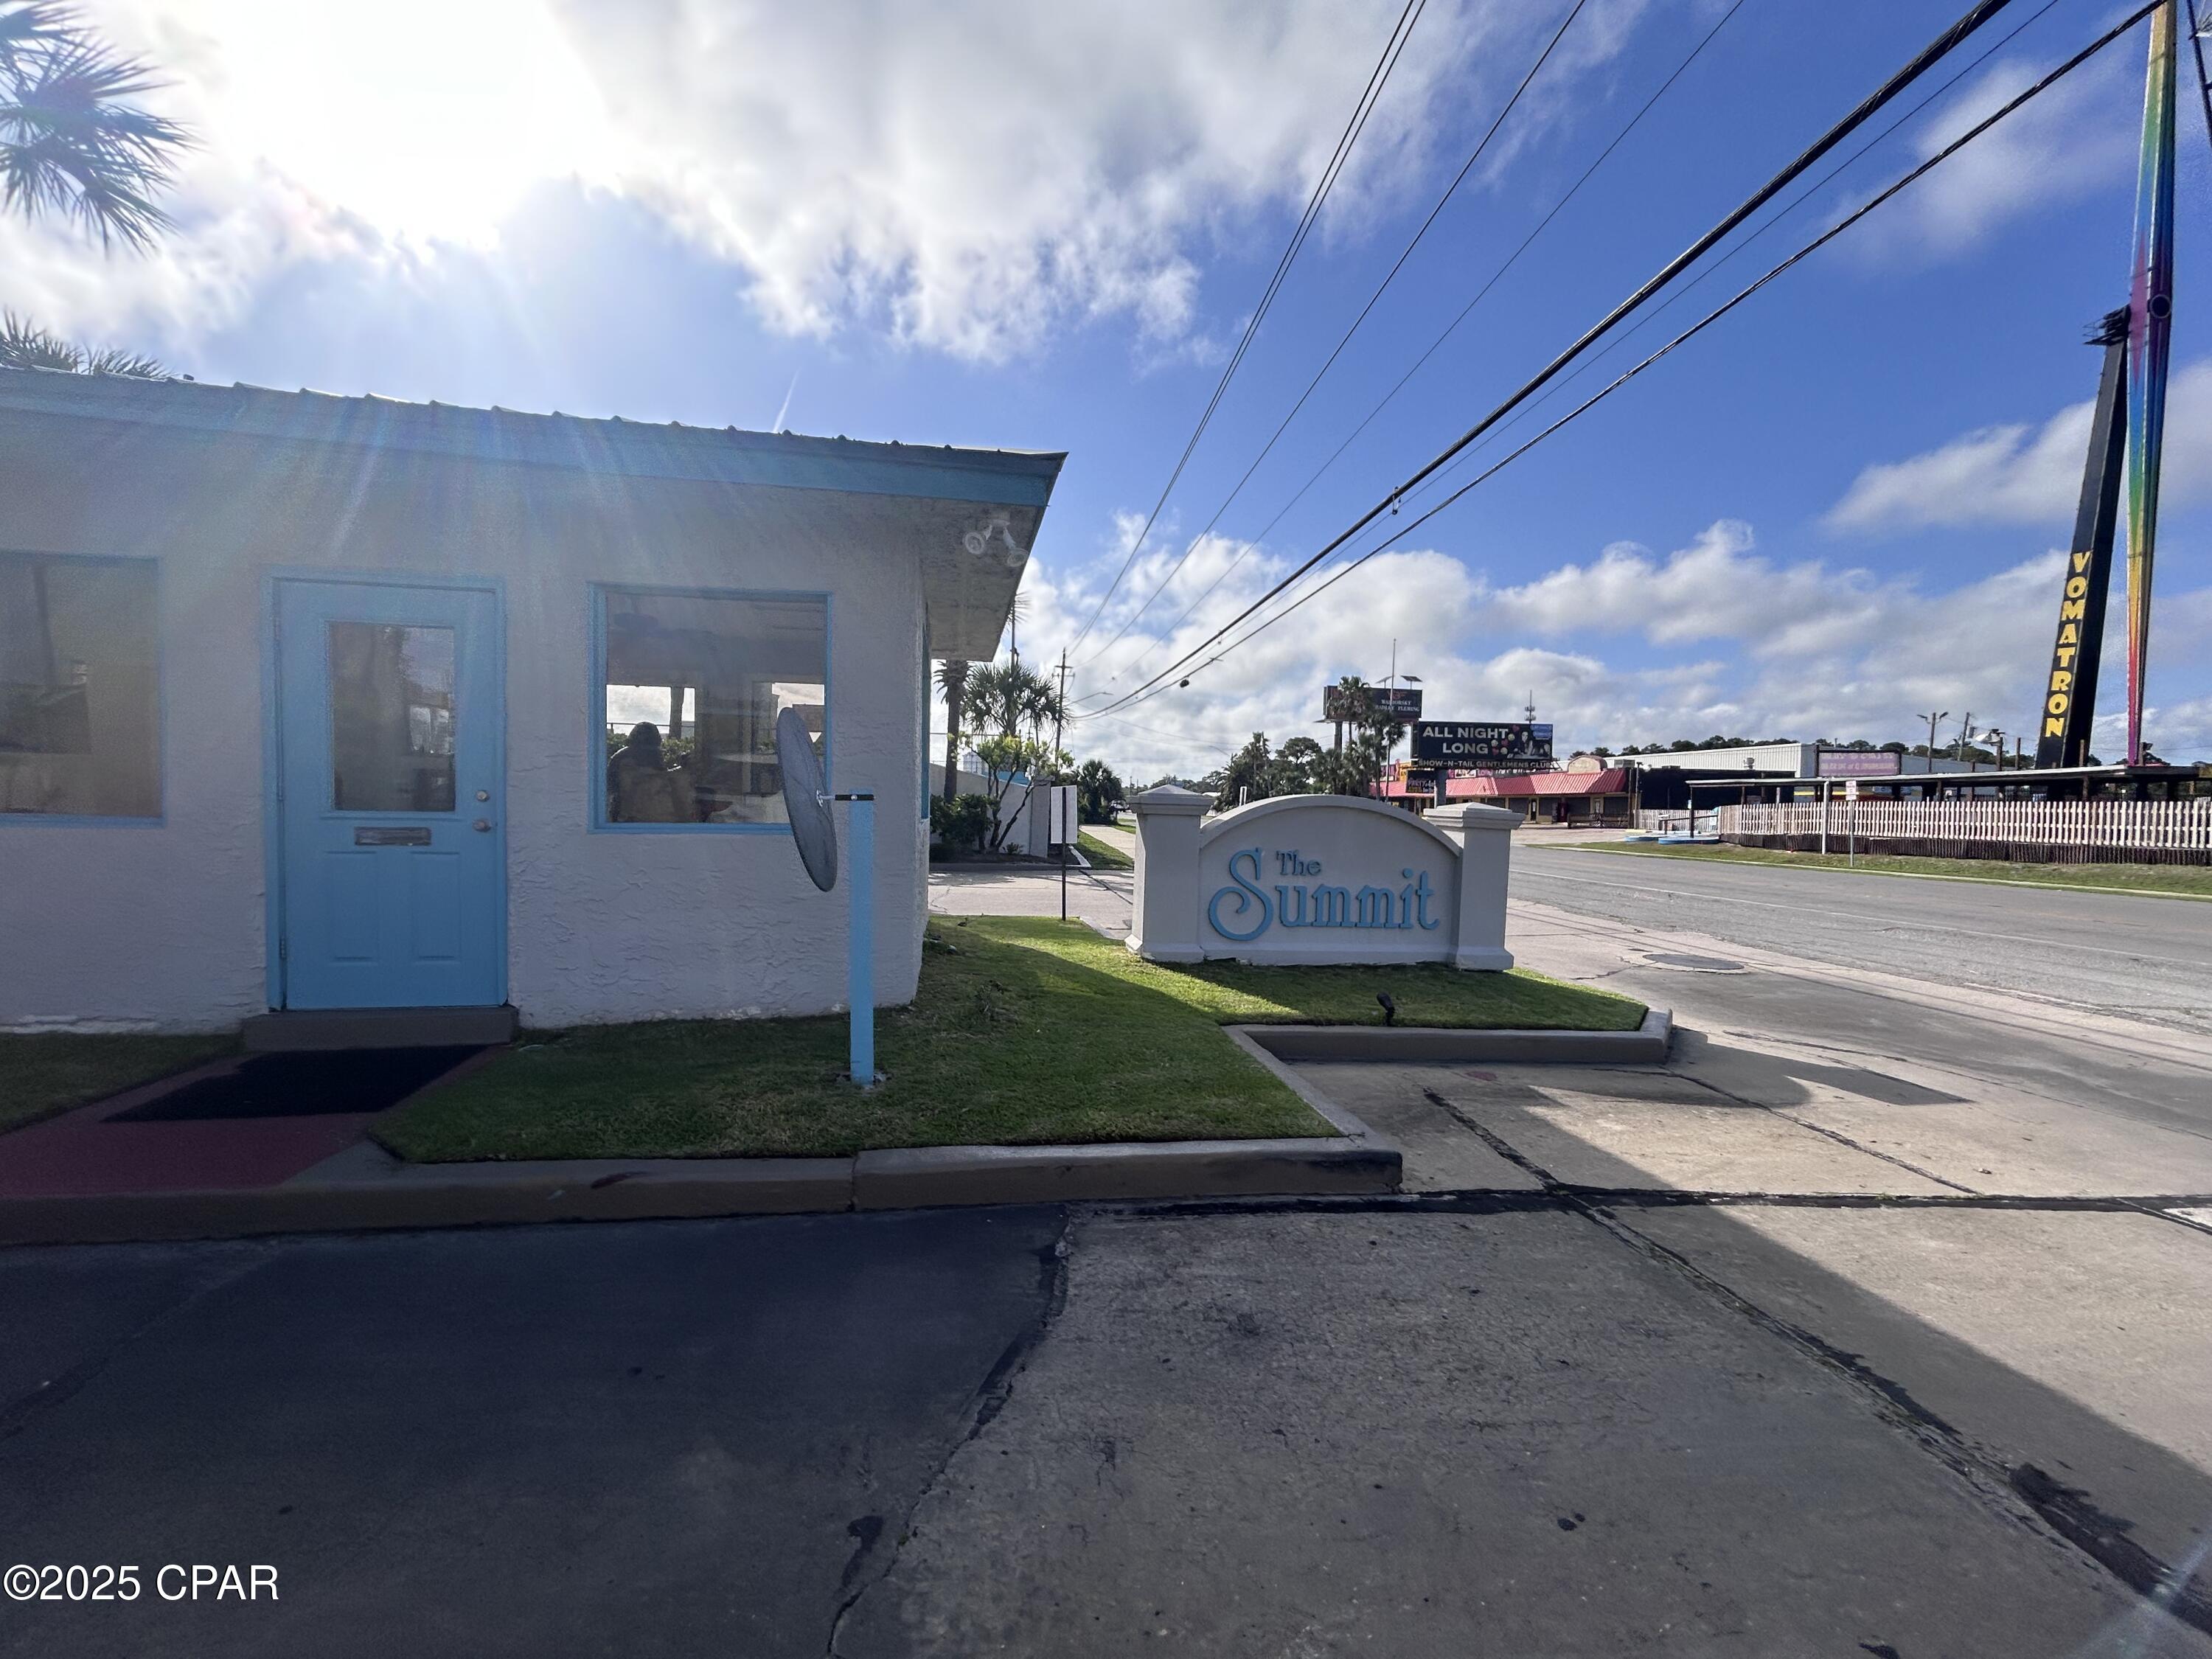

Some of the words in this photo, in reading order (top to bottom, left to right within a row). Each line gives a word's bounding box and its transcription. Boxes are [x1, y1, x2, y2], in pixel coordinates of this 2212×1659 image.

[2045, 551, 2092, 737] VOMATRON
[1422, 726, 1453, 737] ALL
[1458, 727, 1509, 739] NIGHT
[1442, 742, 1489, 754] LONG
[1276, 850, 1321, 876] The
[1208, 848, 1440, 941] Summit
